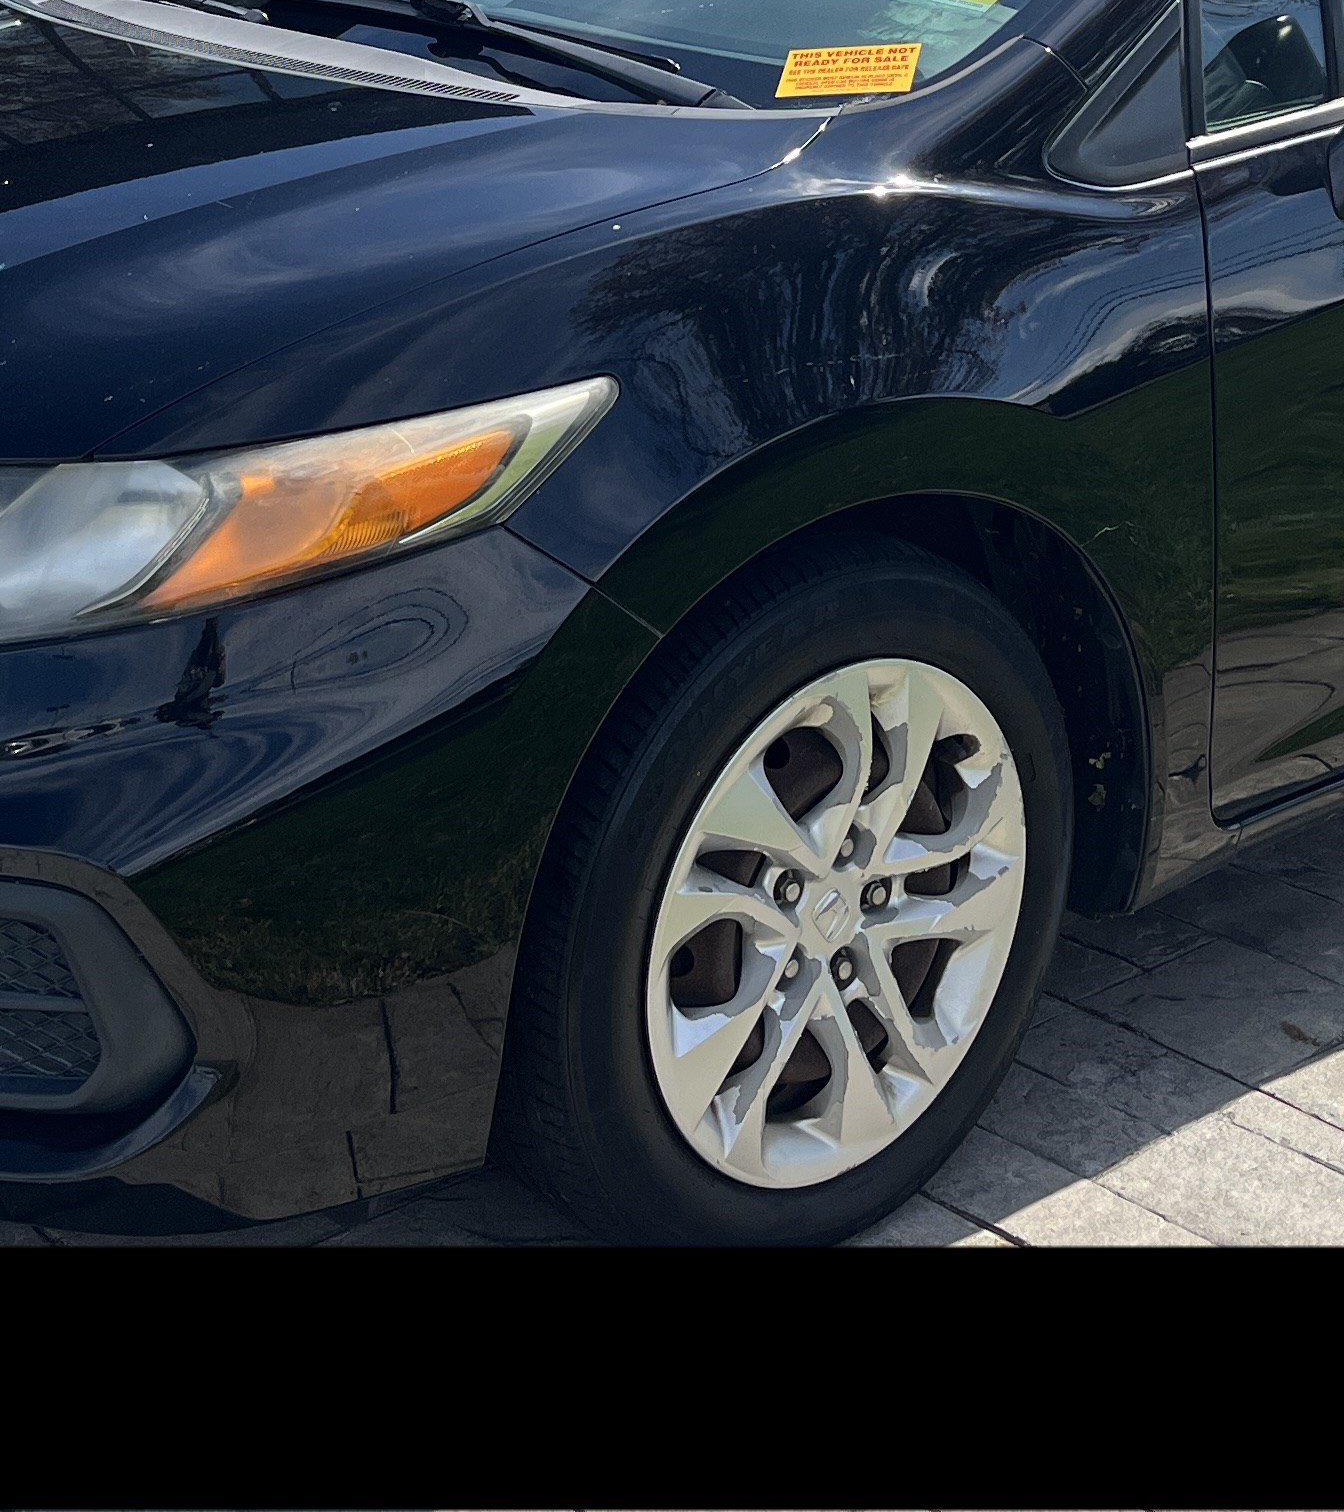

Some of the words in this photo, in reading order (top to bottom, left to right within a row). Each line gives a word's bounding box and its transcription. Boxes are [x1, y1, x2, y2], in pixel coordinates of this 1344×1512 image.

[792, 52, 823, 60] THIS
[827, 48, 885, 58] VEHICLE
[888, 46, 918, 55] NOT
[793, 59, 841, 68] READY
[843, 57, 871, 65] FOR
[873, 55, 910, 63] SALE
